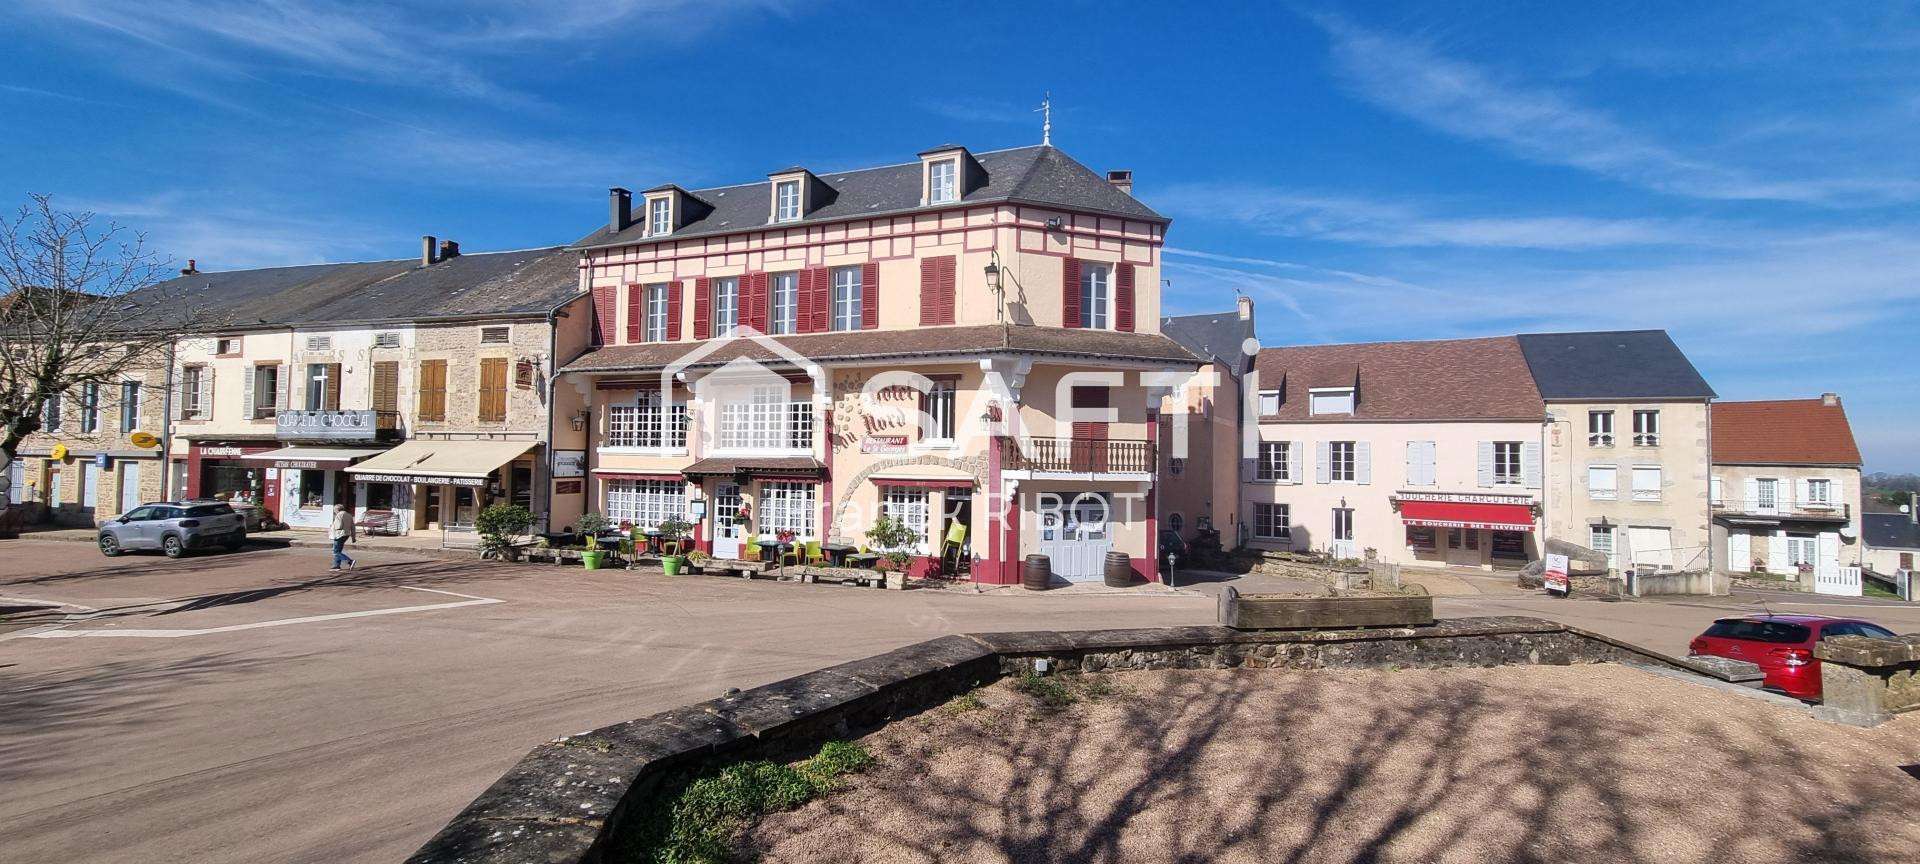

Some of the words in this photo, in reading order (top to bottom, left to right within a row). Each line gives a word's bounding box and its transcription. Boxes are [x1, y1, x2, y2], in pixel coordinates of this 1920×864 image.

[200, 447, 207, 455] LA
[383, 475, 410, 483] CHOCOLAT
[413, 476, 450, 484] BOULANGERIE
[1458, 495, 1530, 505] CHARCUTERIE
